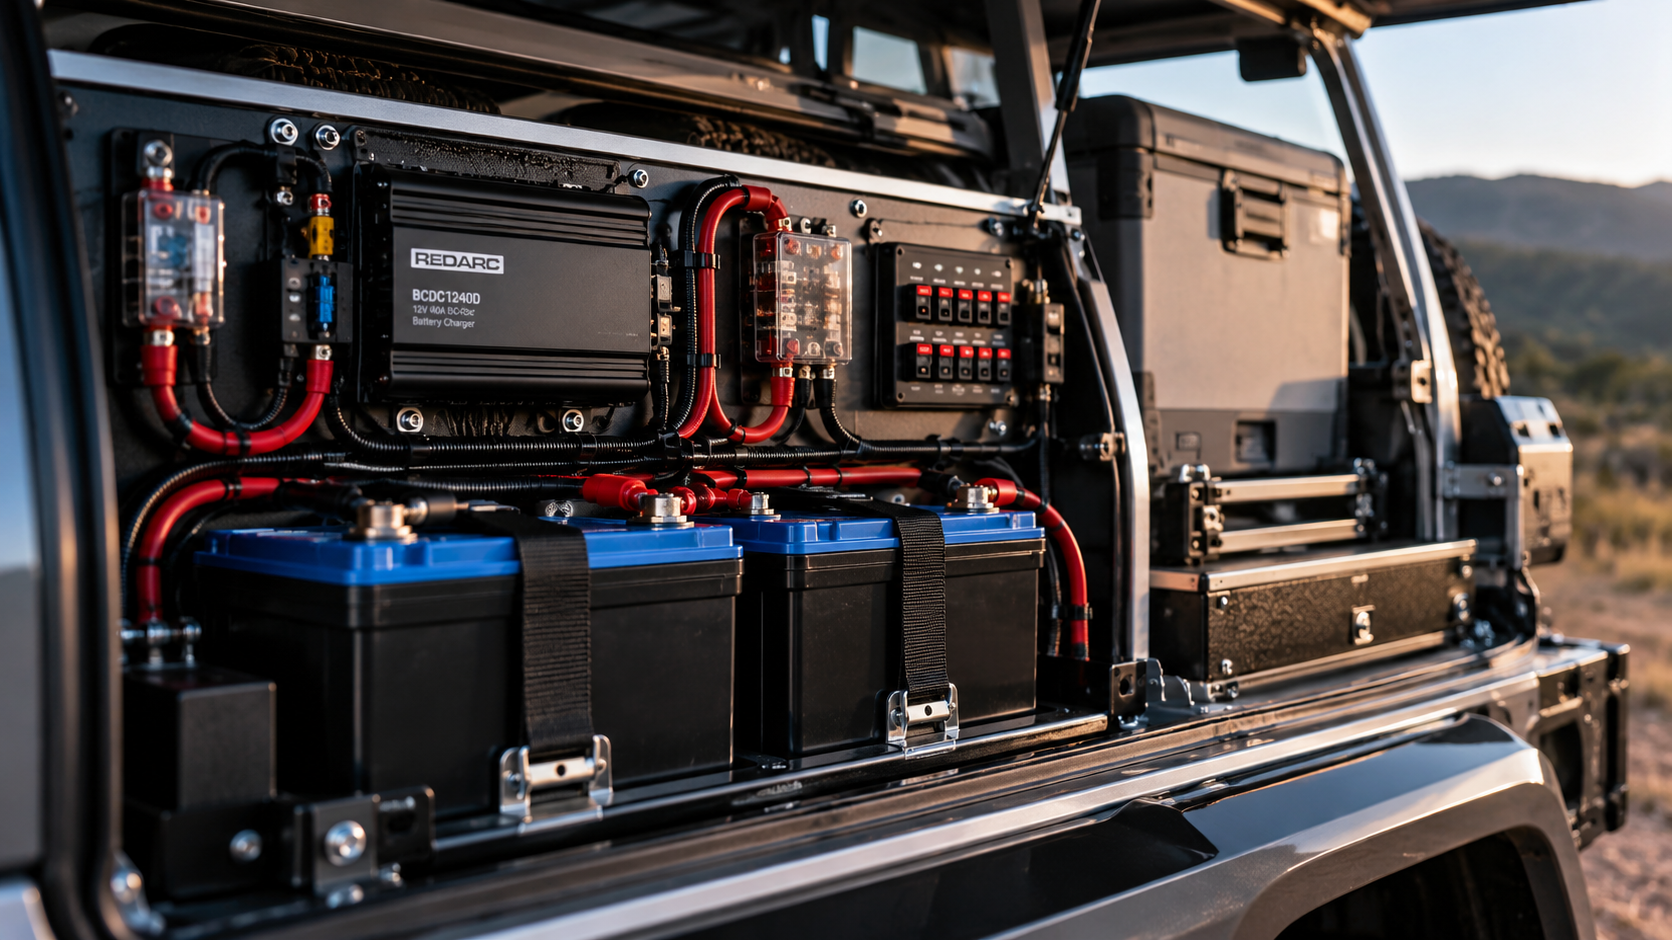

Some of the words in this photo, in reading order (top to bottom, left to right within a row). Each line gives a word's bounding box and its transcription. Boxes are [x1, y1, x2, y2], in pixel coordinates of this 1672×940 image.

[415, 252, 500, 271] REDARC
[412, 288, 481, 305] BCDC1240D
[412, 305, 428, 314] 12V
[412, 316, 442, 328] Battery
[443, 318, 475, 330] Charger
